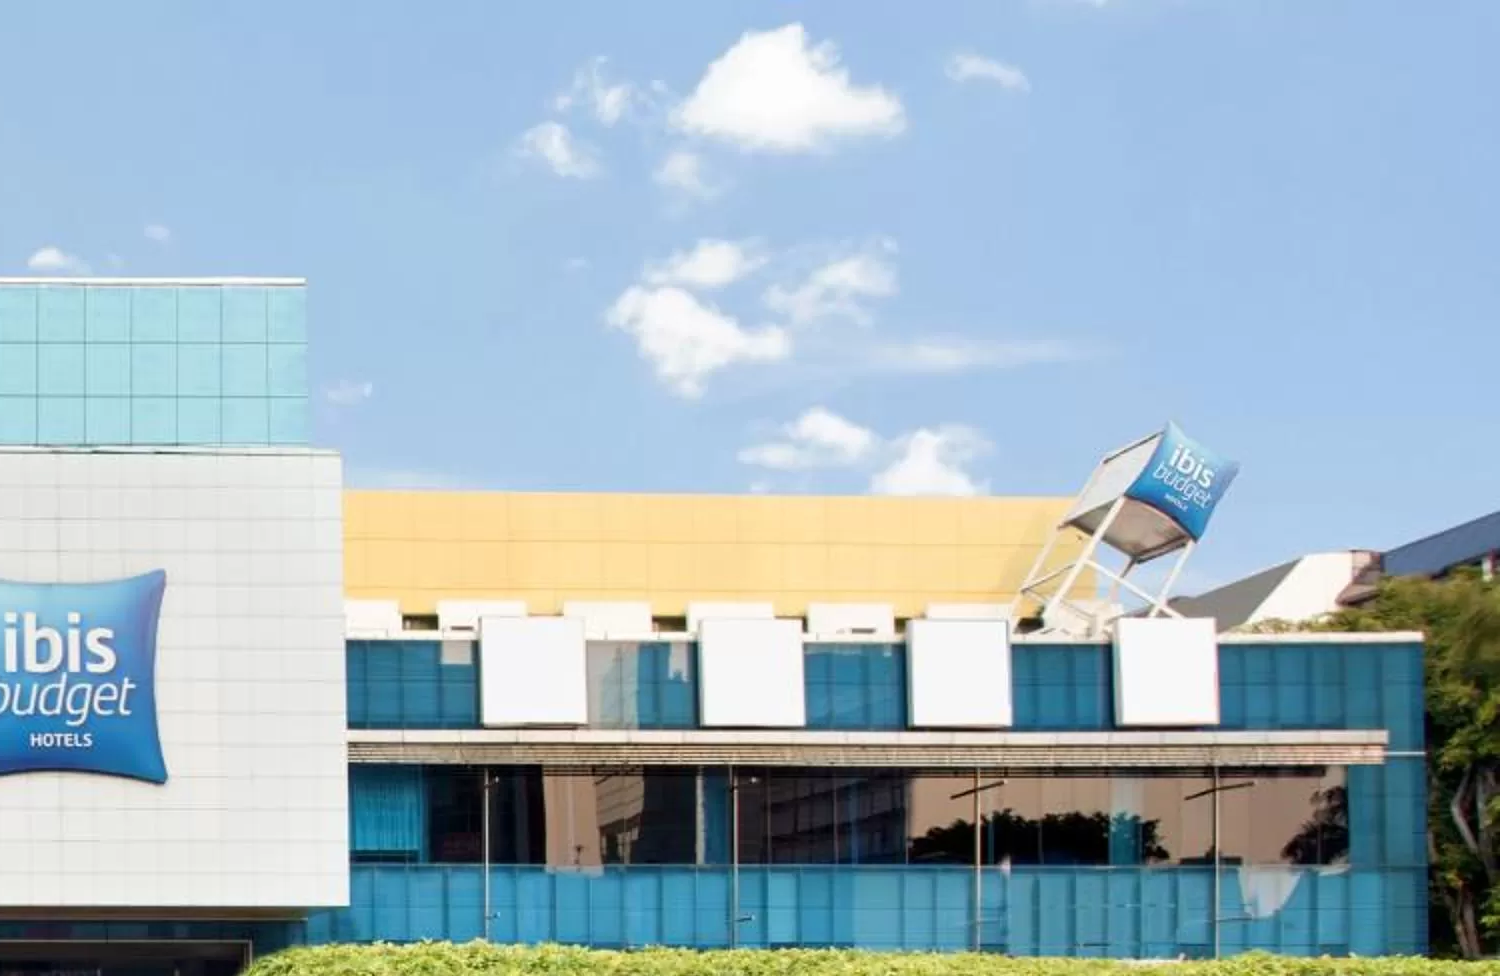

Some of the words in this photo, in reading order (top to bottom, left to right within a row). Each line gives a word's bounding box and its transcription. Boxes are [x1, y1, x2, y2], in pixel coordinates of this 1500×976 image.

[1152, 460, 1213, 510] budget
[1169, 443, 1216, 489] ibis
[3, 612, 117, 673] ibis
[29, 732, 94, 748] HOTELS
